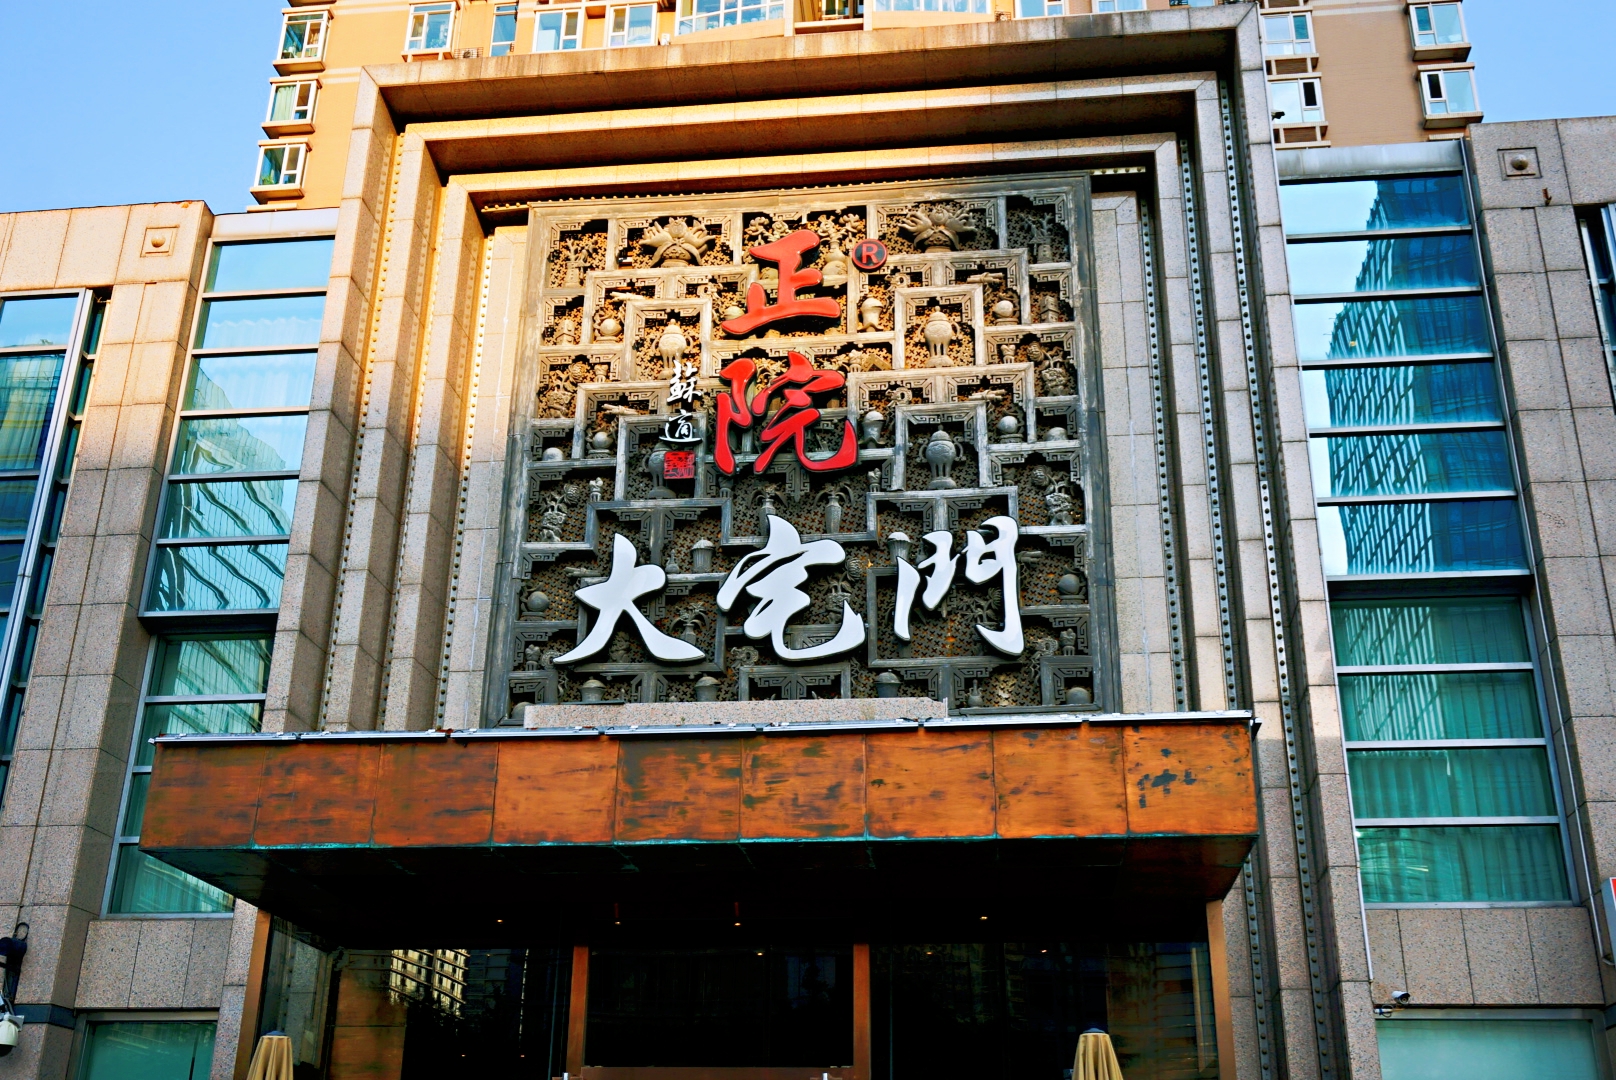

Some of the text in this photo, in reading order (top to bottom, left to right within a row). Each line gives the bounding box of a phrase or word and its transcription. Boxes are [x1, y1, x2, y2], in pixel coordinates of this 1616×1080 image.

[714, 229, 858, 474] 正院
[553, 514, 1024, 664] 大宅門
